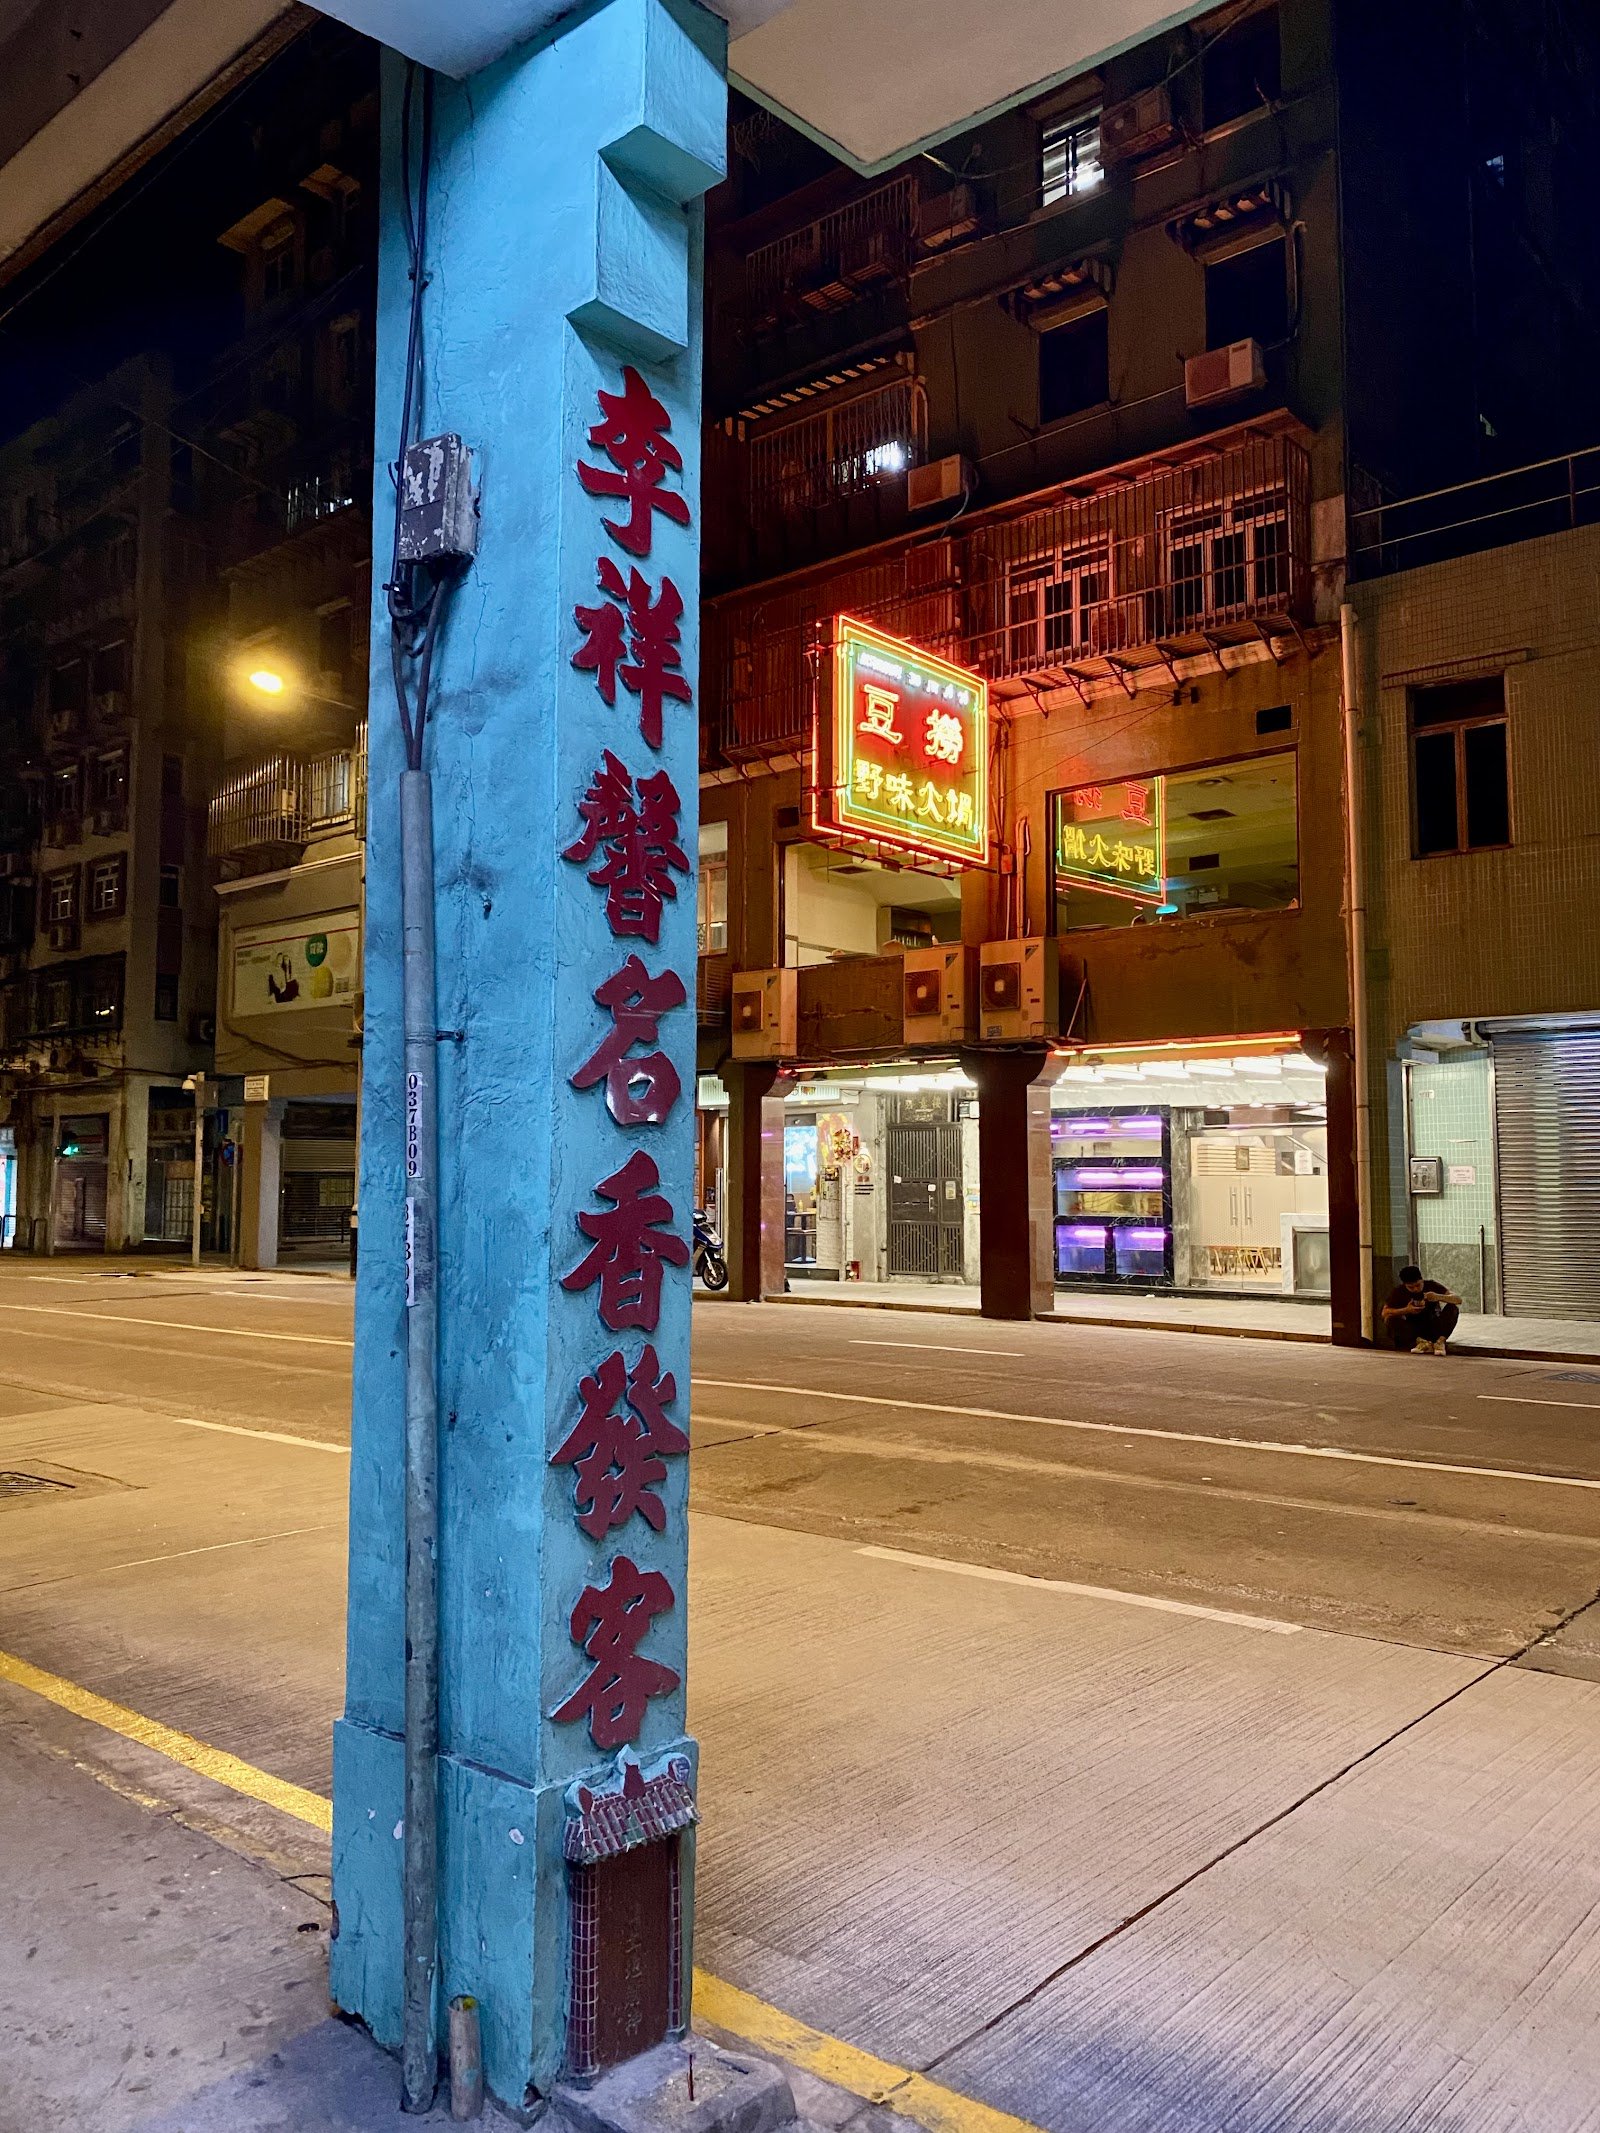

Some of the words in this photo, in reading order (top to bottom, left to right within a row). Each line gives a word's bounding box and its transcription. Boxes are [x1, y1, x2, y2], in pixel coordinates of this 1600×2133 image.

[858, 684, 964, 764] 豆撈
[854, 758, 974, 831] 野味火鍋
[550, 366, 692, 1750] 李祥馨名香發客
[407, 1074, 418, 1176] 037B09
